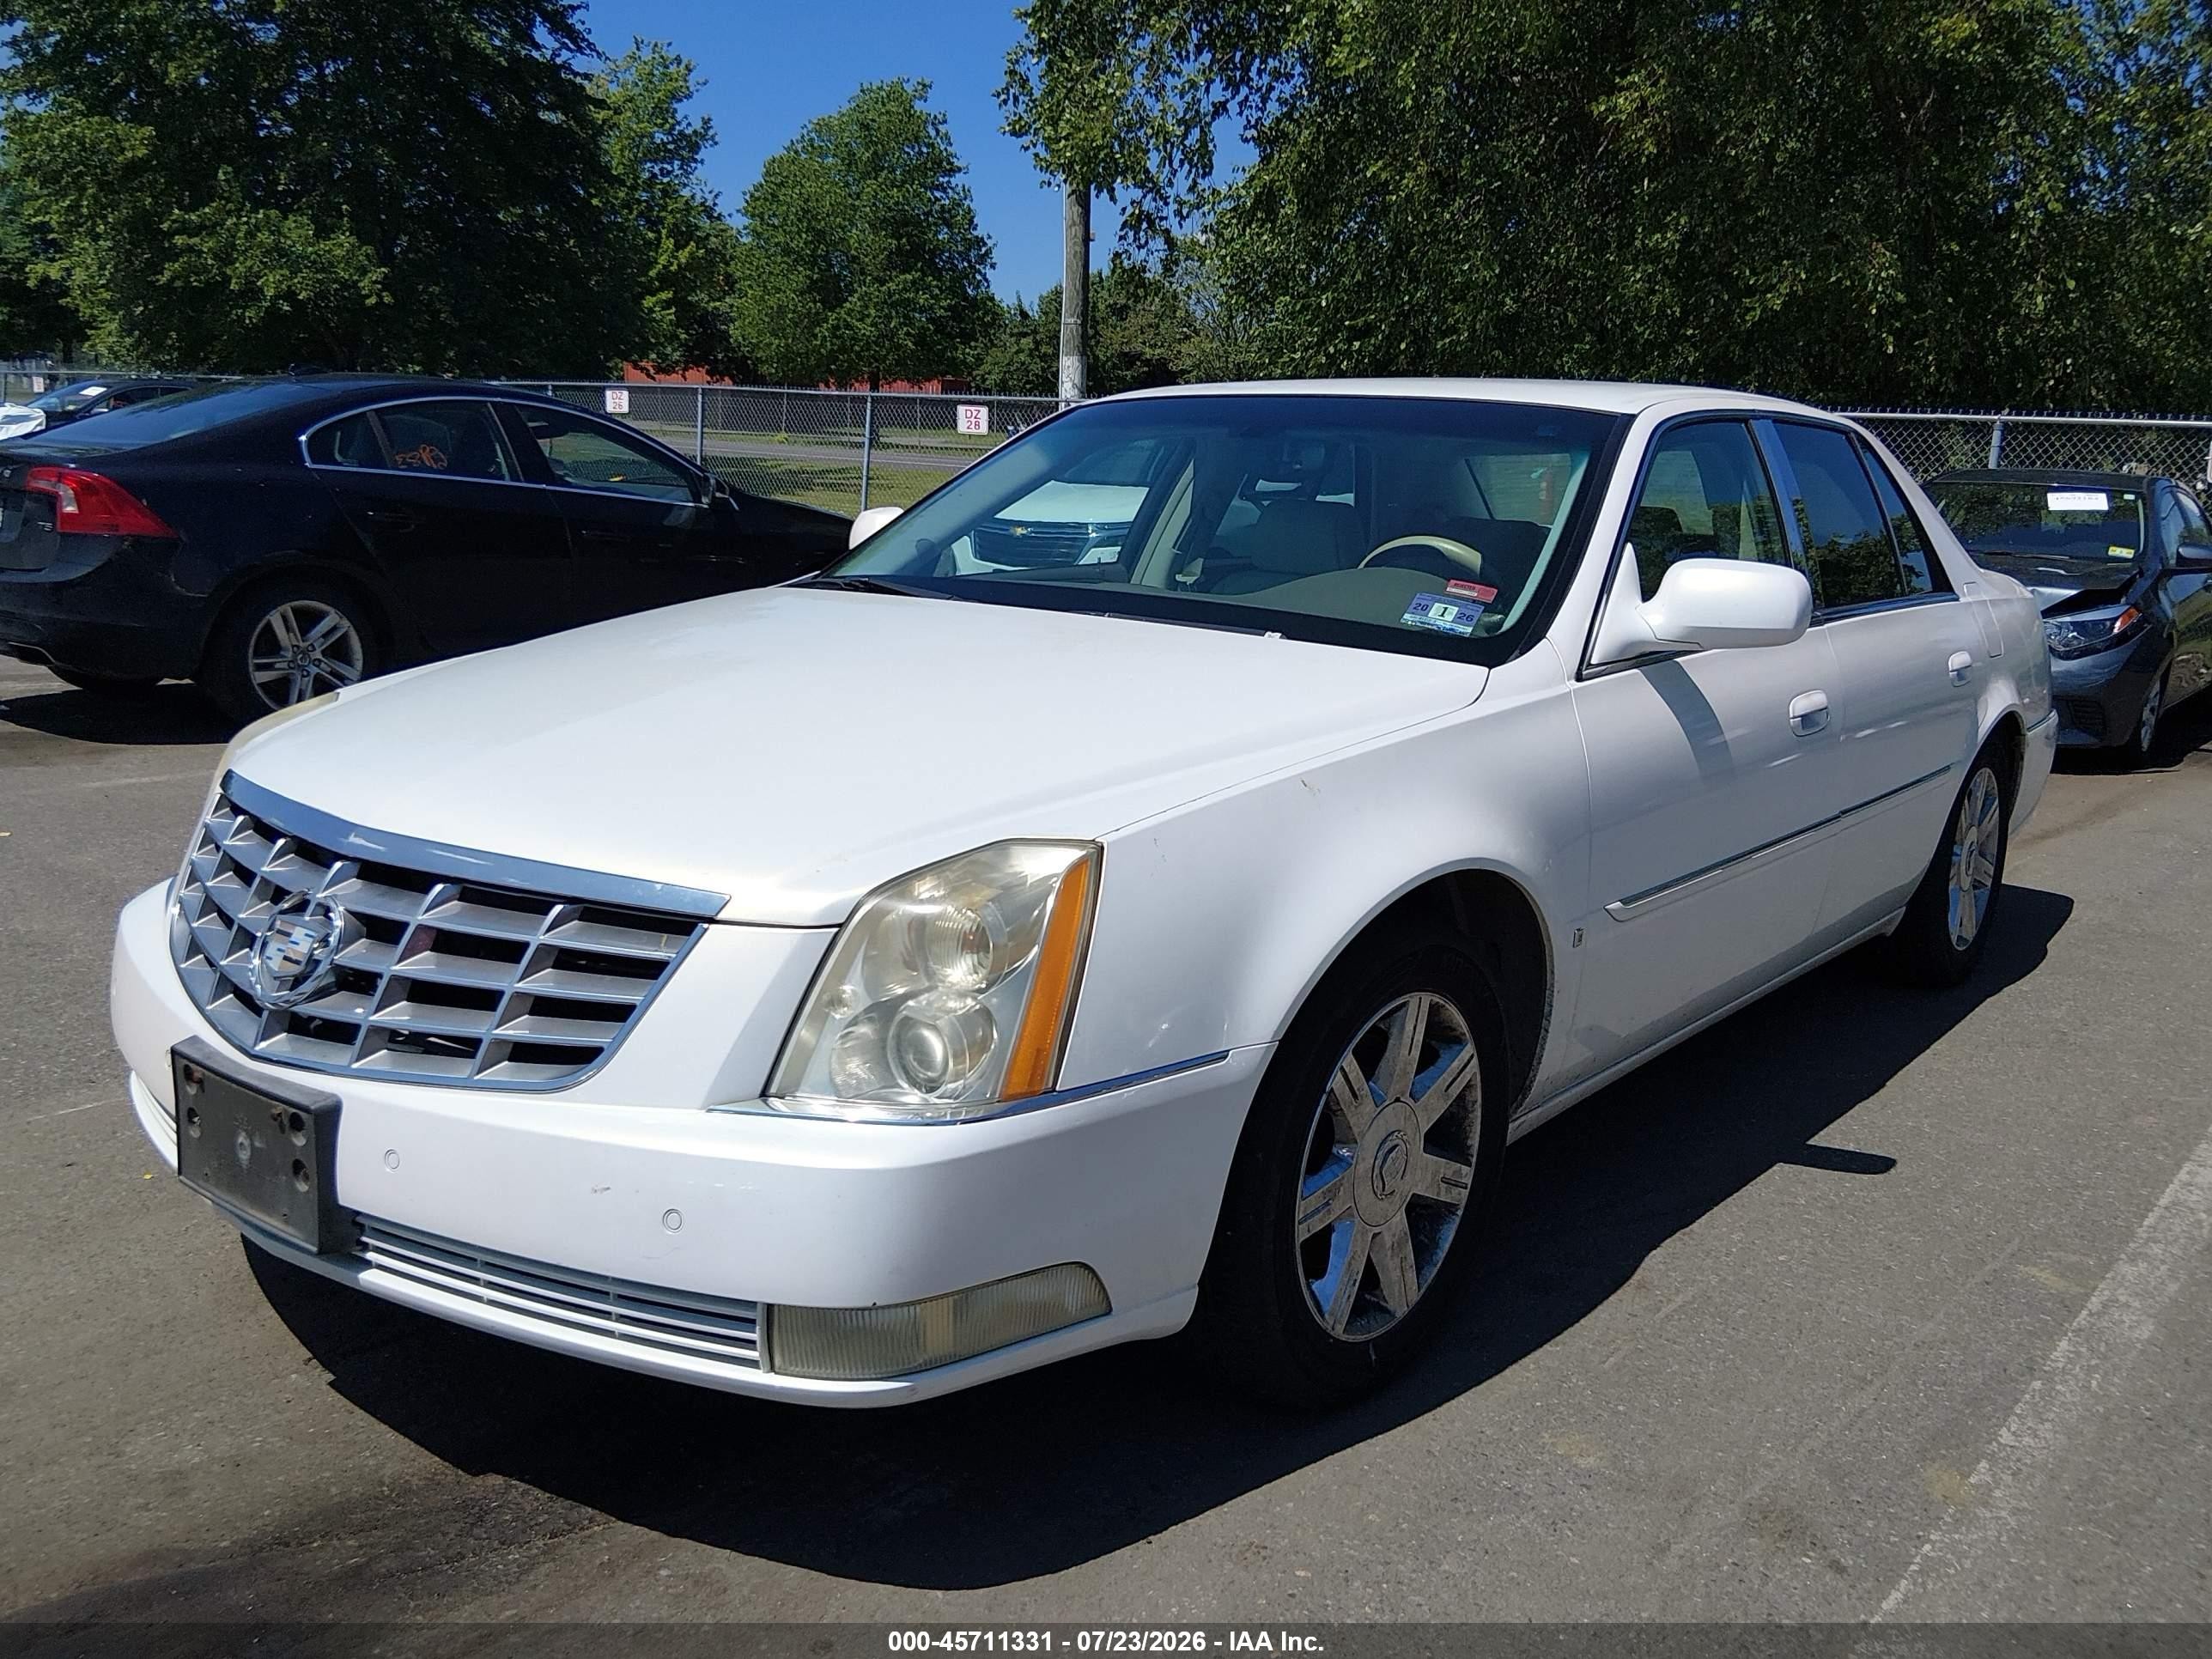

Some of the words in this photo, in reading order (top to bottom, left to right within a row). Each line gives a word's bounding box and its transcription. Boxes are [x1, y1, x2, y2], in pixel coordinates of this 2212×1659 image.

[611, 392, 624, 400] DZ
[612, 401, 623, 410] 26
[964, 409, 981, 420] DZ
[966, 420, 981, 430] 28
[1413, 603, 1430, 612] 20
[1437, 606, 1449, 618] 1
[1456, 612, 1475, 623] 26
